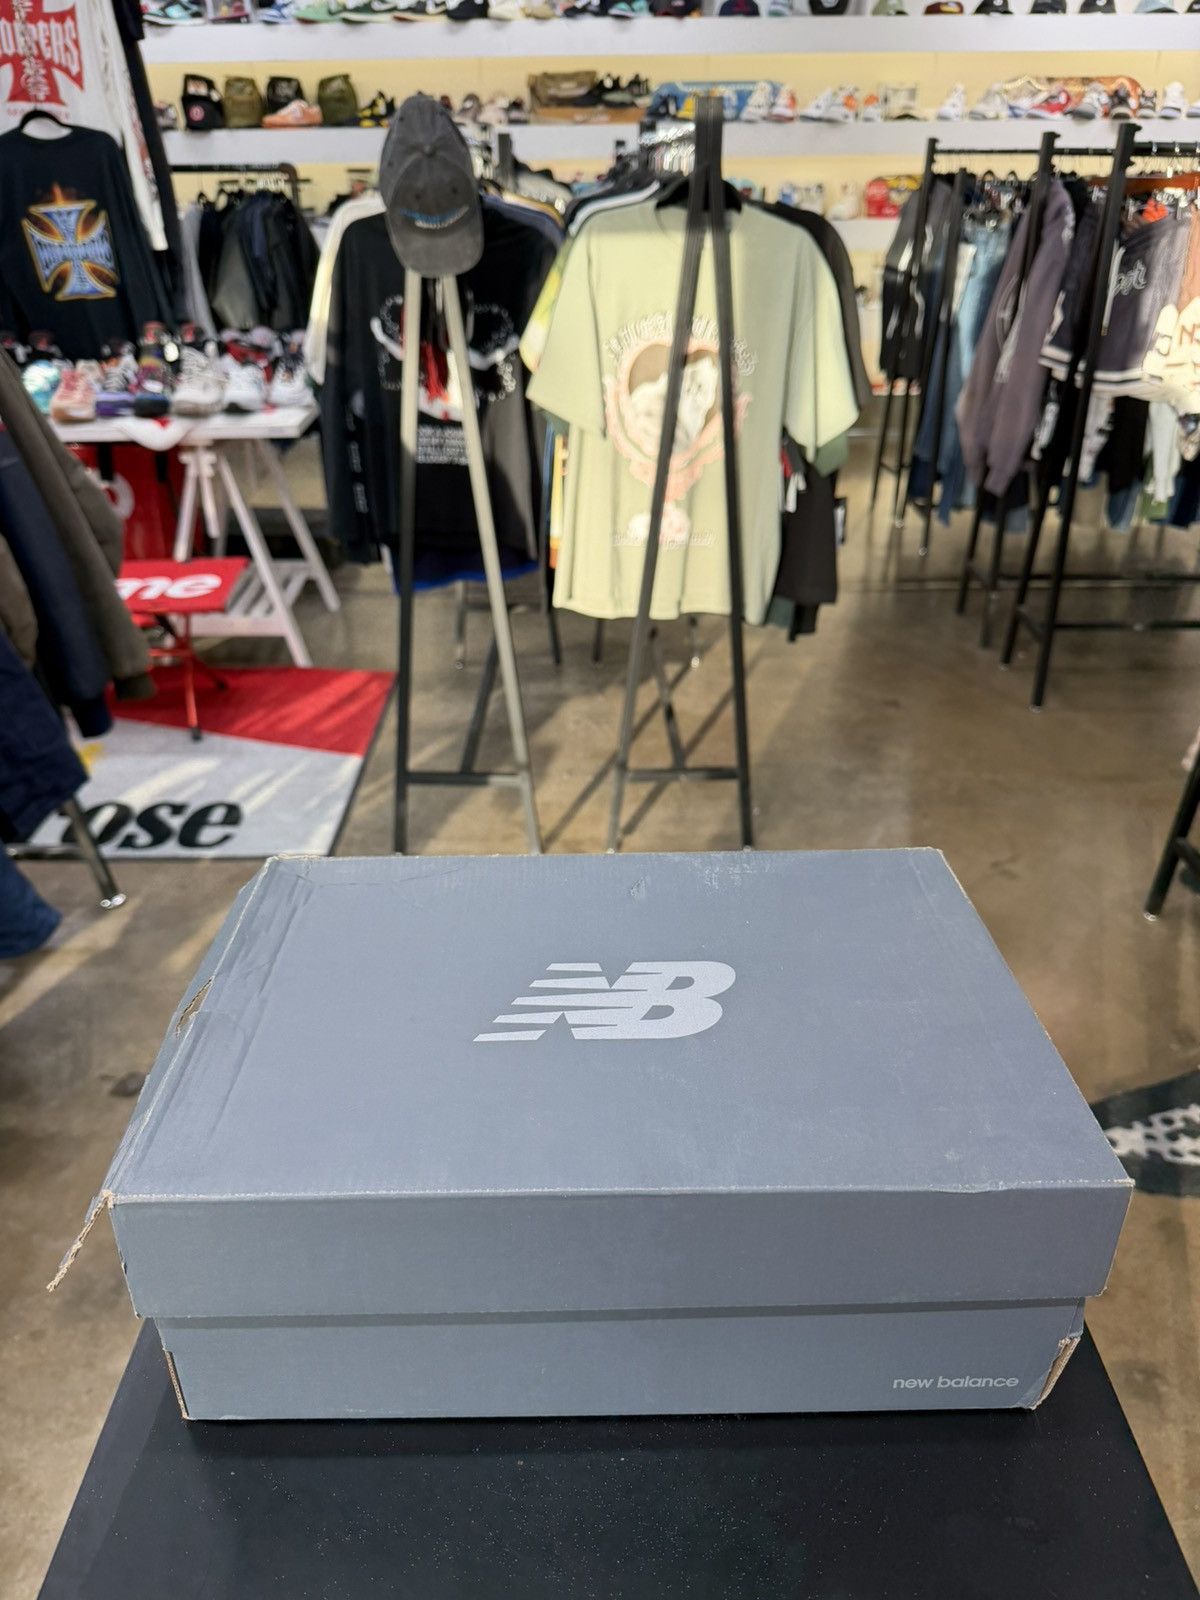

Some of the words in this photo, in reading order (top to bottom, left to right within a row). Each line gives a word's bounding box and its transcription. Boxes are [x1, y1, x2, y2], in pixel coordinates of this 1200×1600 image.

[57, 801, 242, 849] ose
[472, 960, 736, 1042] NB
[892, 1376, 934, 1389] new
[936, 1375, 1019, 1389] balance
